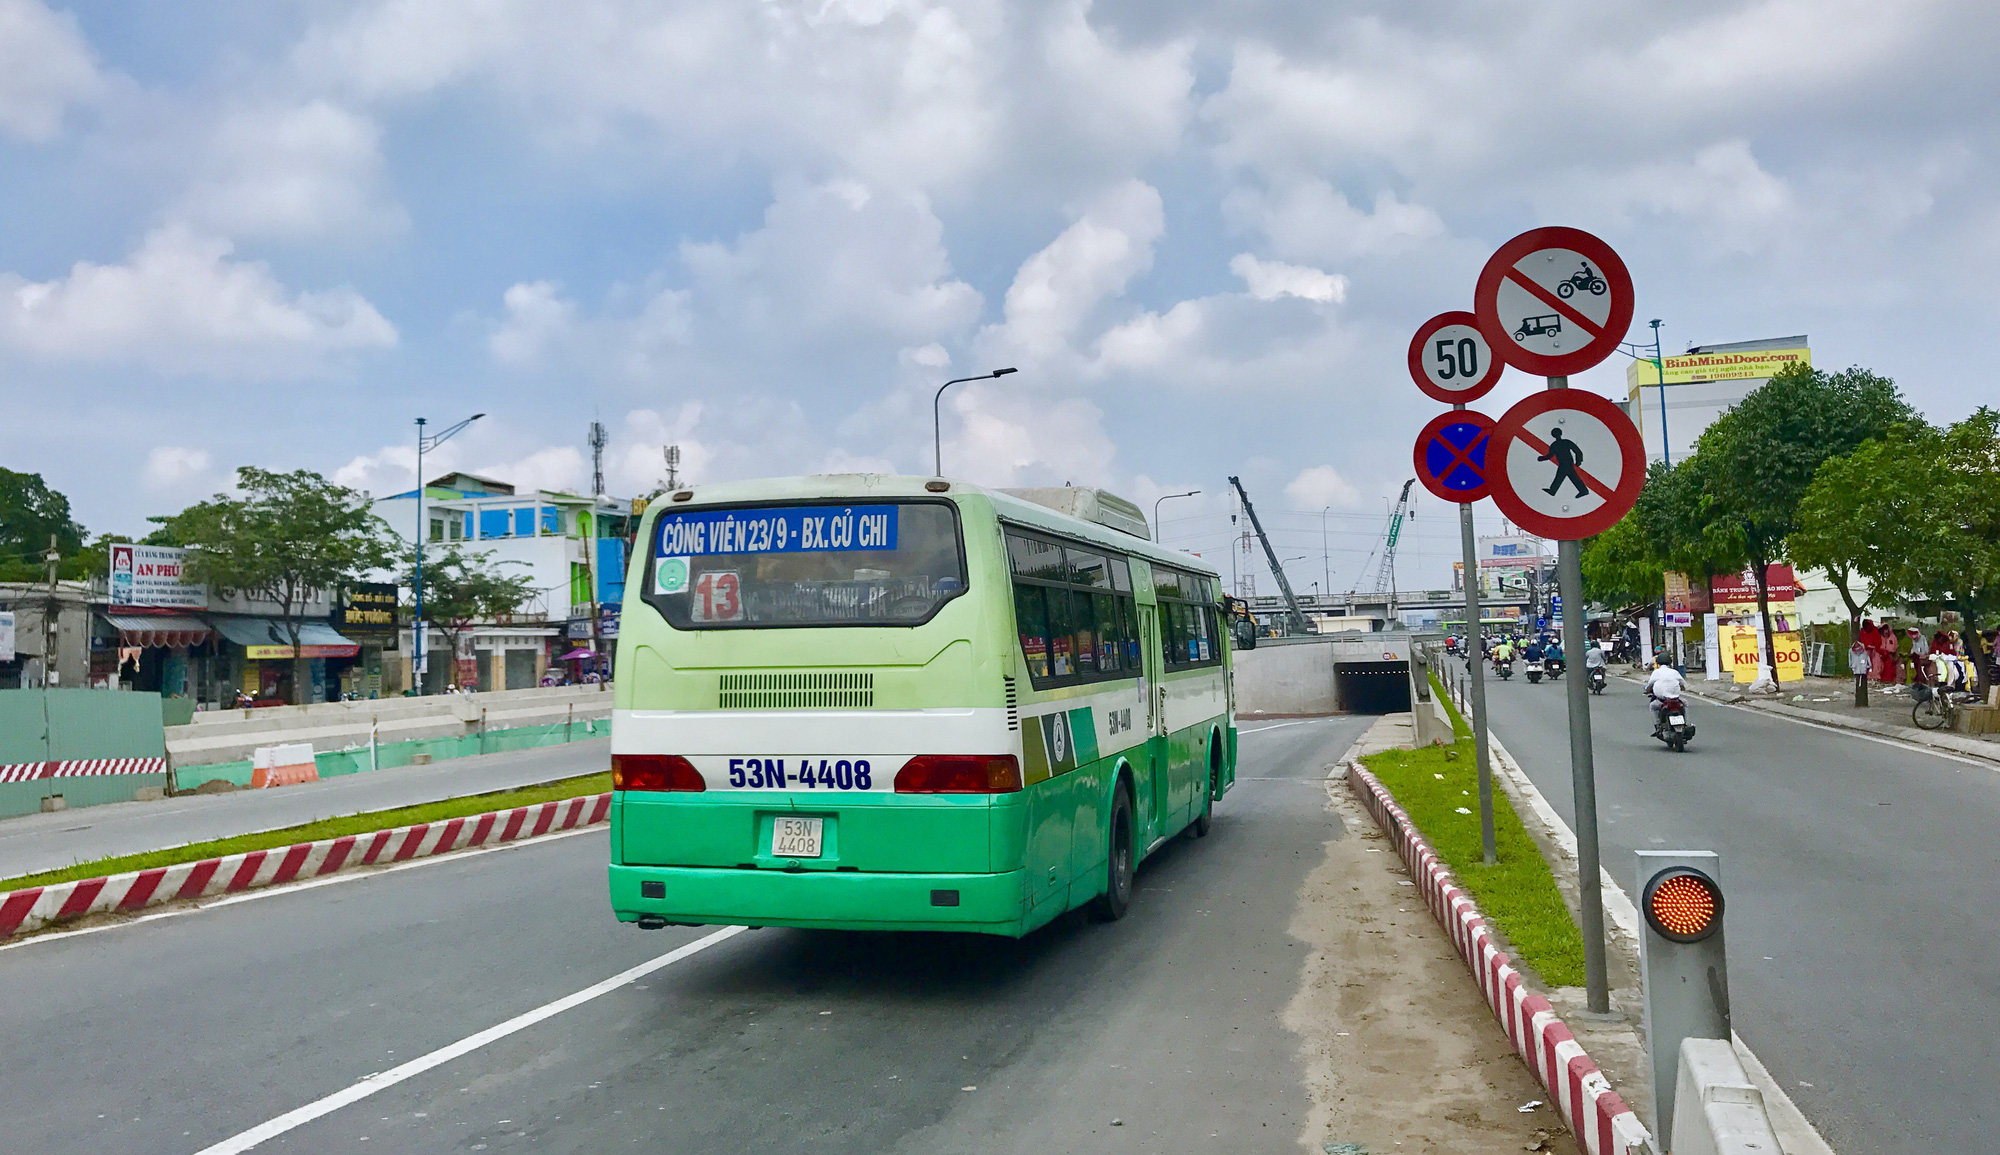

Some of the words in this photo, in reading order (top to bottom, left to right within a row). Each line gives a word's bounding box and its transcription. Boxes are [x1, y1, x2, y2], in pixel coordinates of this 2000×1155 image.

[1436, 338, 1477, 379] 50
[1665, 353, 1798, 369] BinhMinhDoor.com
[663, 516, 705, 555] CÔNG
[709, 514, 748, 553] VIÊN
[748, 517, 787, 550] 23/9
[859, 514, 888, 547] CHI
[136, 562, 154, 577] AN
[697, 573, 740, 621] 13
[1734, 653, 1760, 664] KIN
[1776, 648, 1800, 663] ĐÔ
[729, 759, 872, 790] 53N-4408
[785, 821, 812, 837] 53N
[778, 837, 815, 853] 4408
